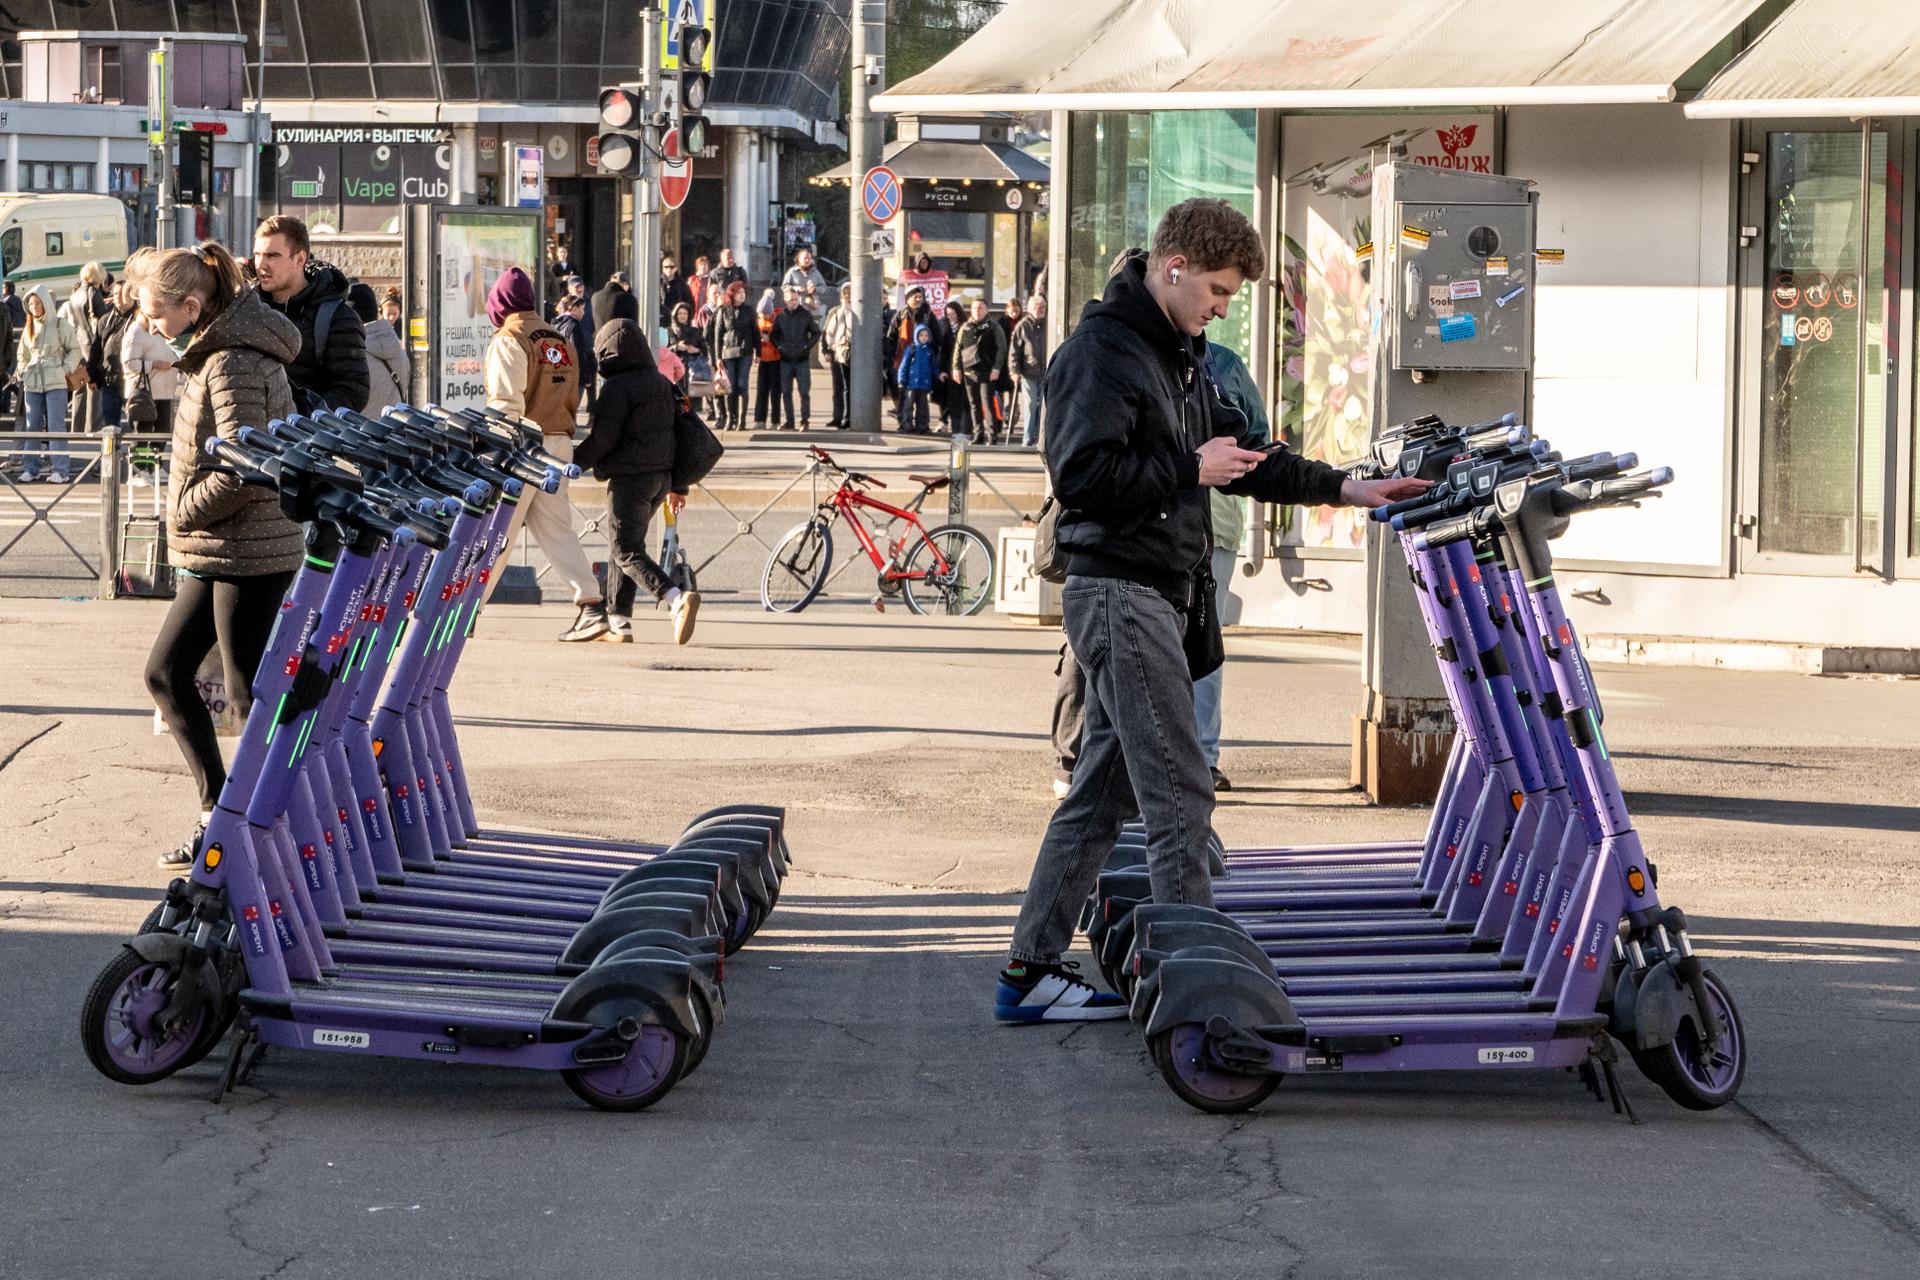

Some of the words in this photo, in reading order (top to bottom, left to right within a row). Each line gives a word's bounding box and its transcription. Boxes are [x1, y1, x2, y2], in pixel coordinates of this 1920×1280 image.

[277, 128, 363, 143] КУЛИНАРИЯ
[372, 128, 445, 143] ВЫПЕЧКА
[344, 177, 396, 203] Vape
[403, 177, 449, 198] Club
[925, 193, 968, 201] РУССКАЯ
[446, 326, 475, 341] РЕШИЛ,
[477, 325, 493, 339] ЧТО
[446, 344, 477, 358] КАШЕЛЬ
[446, 362, 456, 376] НЕ
[457, 362, 481, 376] ИЗ-ЗА
[446, 382, 461, 401] Да
[463, 381, 486, 400] бро
[451, 545, 469, 581] ЮРЕНТ
[383, 564, 401, 603] ЮРЕНТ
[339, 588, 358, 632] ЮРЕНТ
[296, 607, 316, 652] ЮРЕНТ
[1570, 648, 1588, 693] ЮРЕНТ
[1533, 873, 1546, 901] ЮРЕНТ
[250, 922, 264, 953] ЮРЕНТ
[276, 918, 293, 947] ЮРЕНТ
[1590, 922, 1603, 953] ЮРЕНТ
[321, 1033, 363, 1044] 151-958
[1487, 1050, 1528, 1063] 159-400
